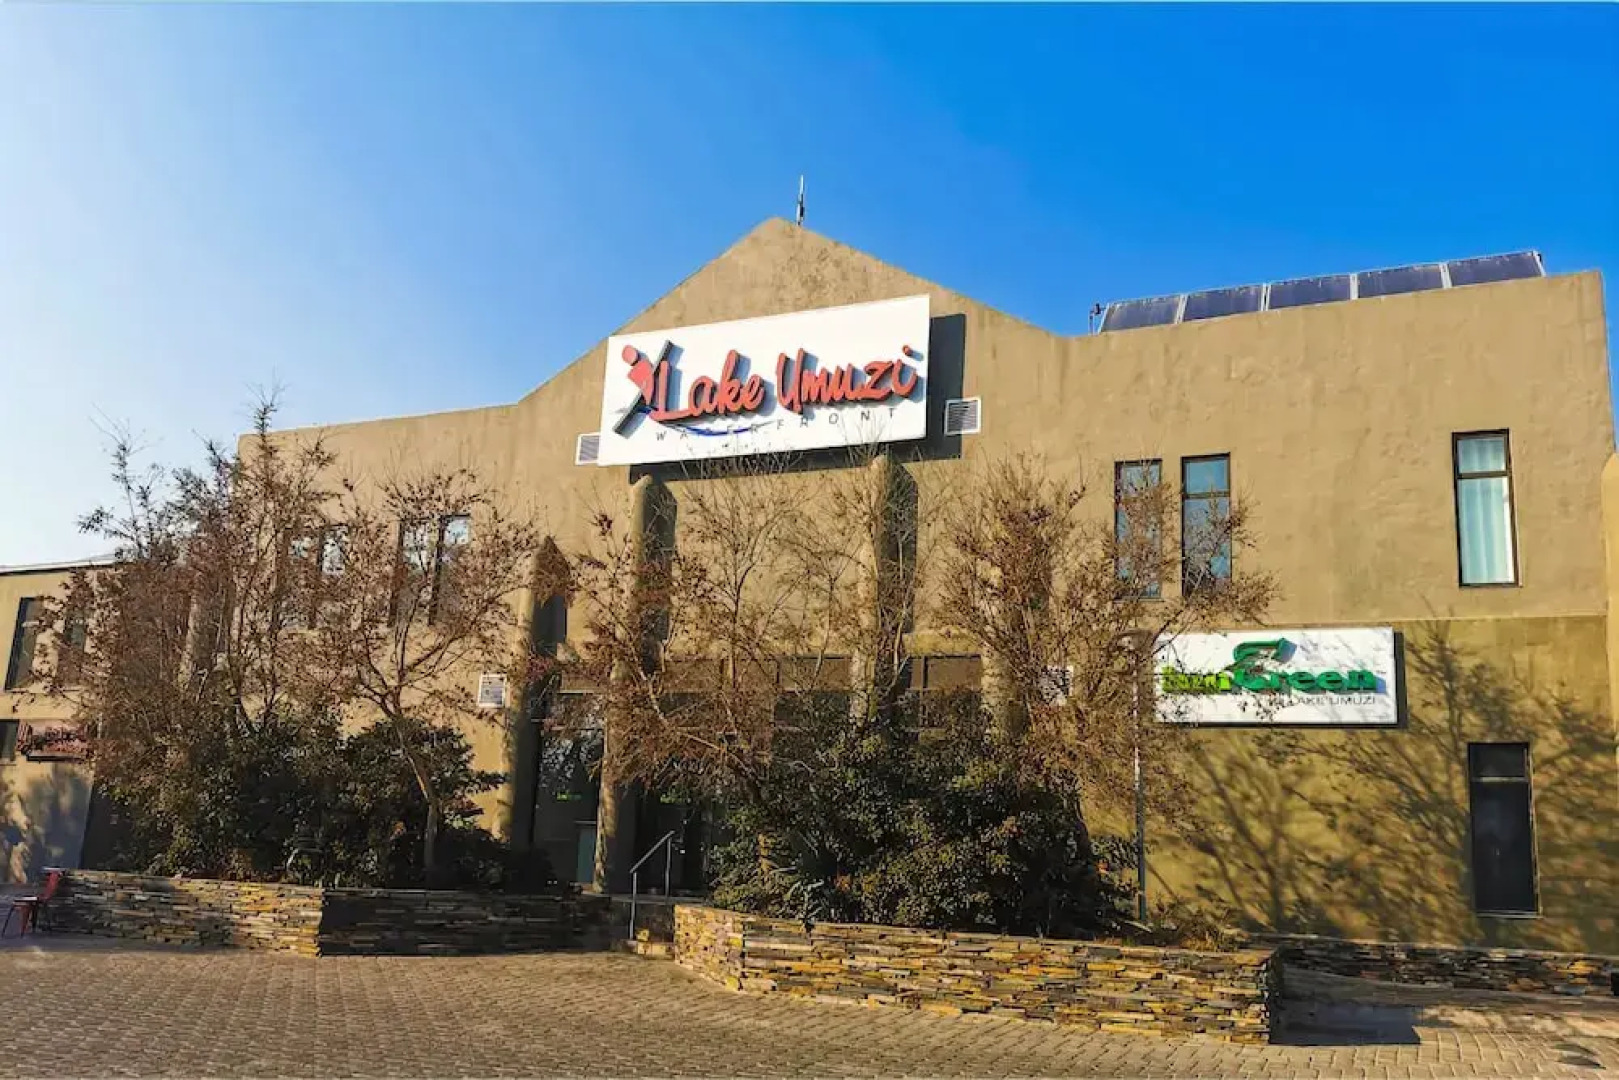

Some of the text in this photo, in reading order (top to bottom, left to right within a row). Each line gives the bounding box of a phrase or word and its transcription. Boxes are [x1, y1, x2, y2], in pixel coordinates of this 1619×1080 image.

[649, 345, 918, 423] Lake Umuzi
[655, 407, 897, 442] WAERFRONT
[1329, 693, 1376, 705] UMUZI
